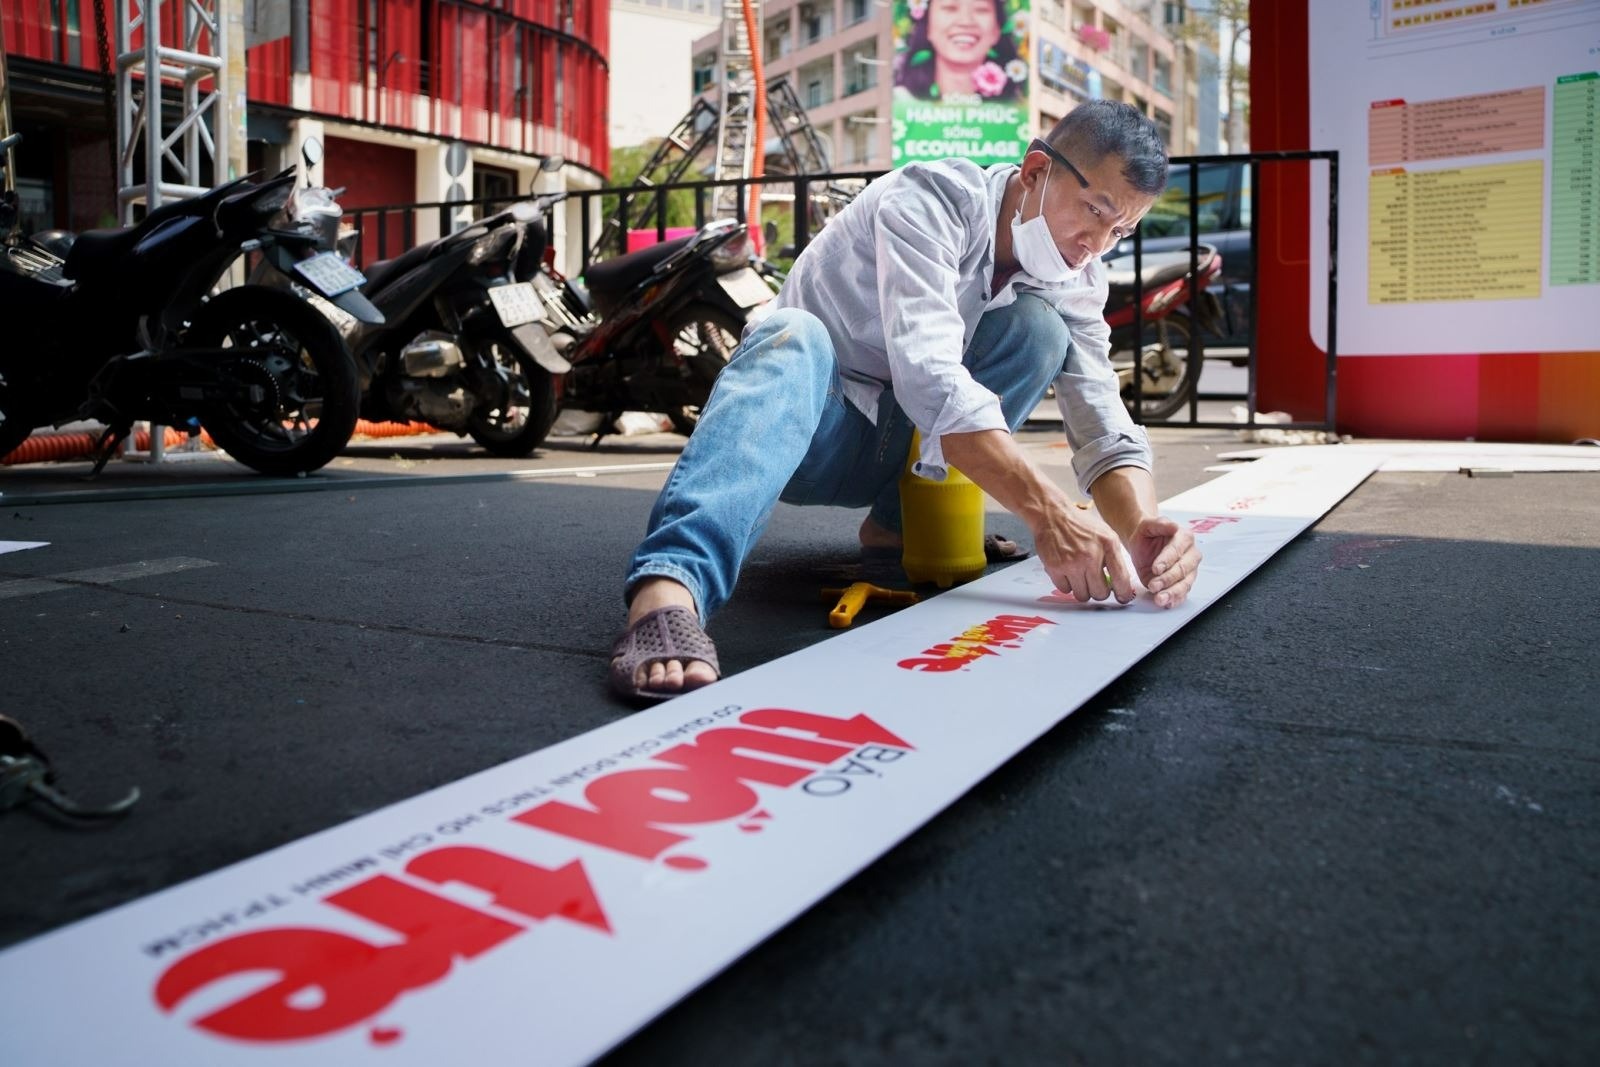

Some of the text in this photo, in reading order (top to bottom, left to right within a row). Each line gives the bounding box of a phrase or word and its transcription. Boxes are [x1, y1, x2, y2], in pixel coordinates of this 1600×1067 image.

[906, 105, 1019, 126] HẠNH PHÚC
[904, 140, 1020, 156] ECOVILLAGE
[801, 744, 906, 797] BÁO
[291, 856, 379, 895] MINH
